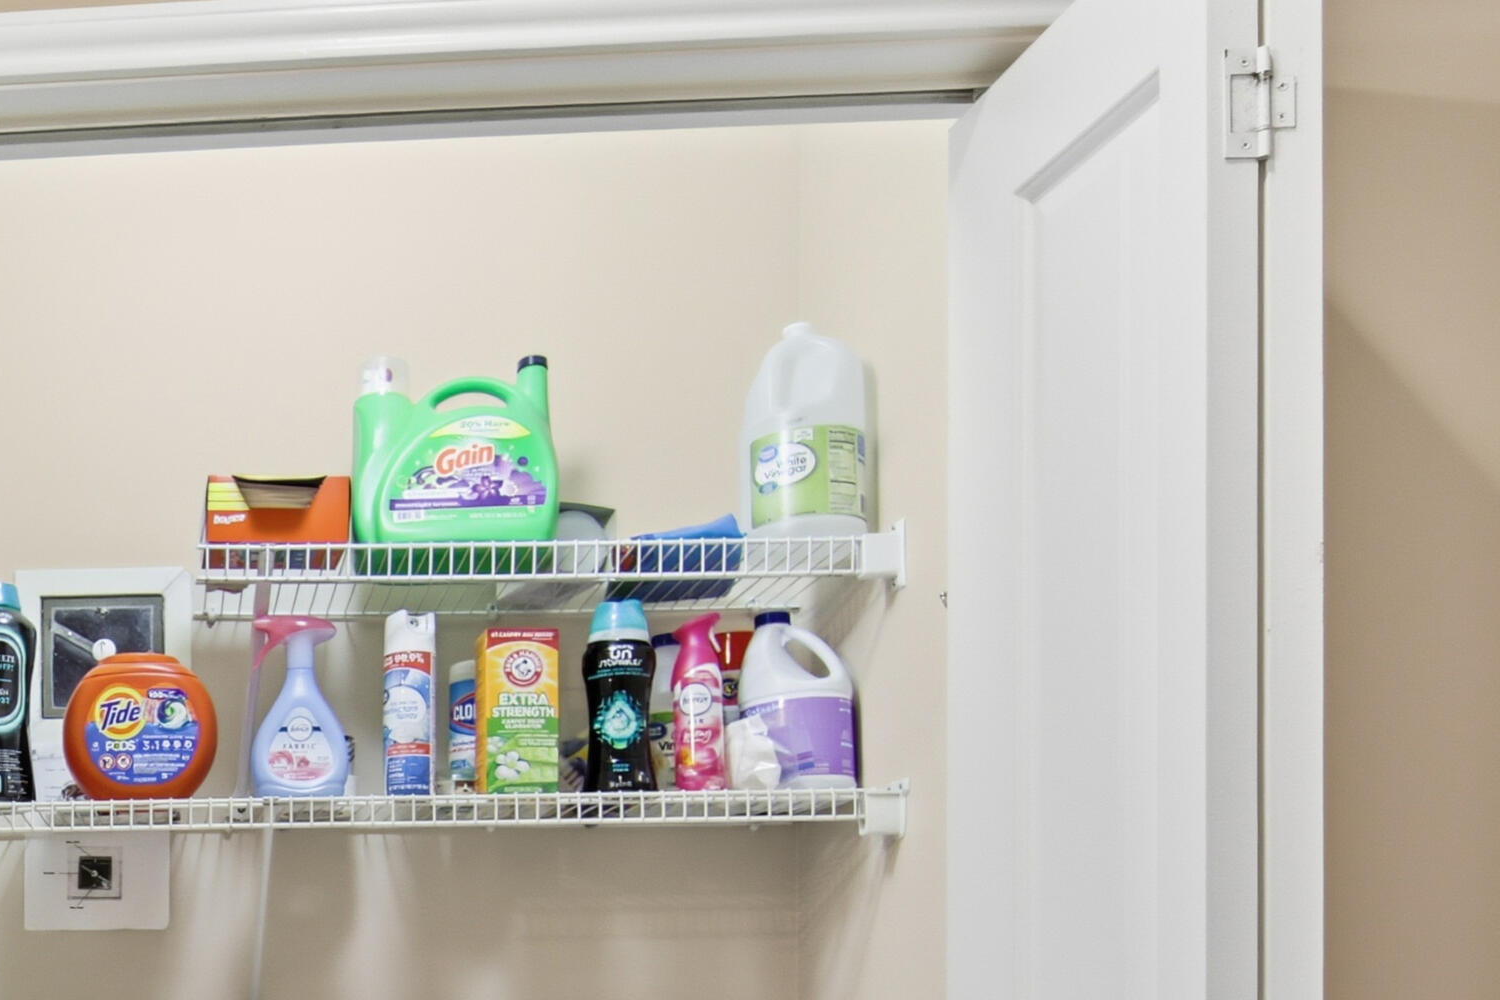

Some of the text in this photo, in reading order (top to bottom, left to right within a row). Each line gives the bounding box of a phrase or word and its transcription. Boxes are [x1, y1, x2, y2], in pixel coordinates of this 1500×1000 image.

[436, 444, 493, 475] Gain
[499, 693, 549, 706] EXTRA
[100, 700, 141, 731] Tide
[492, 706, 555, 718] STRENGTH
